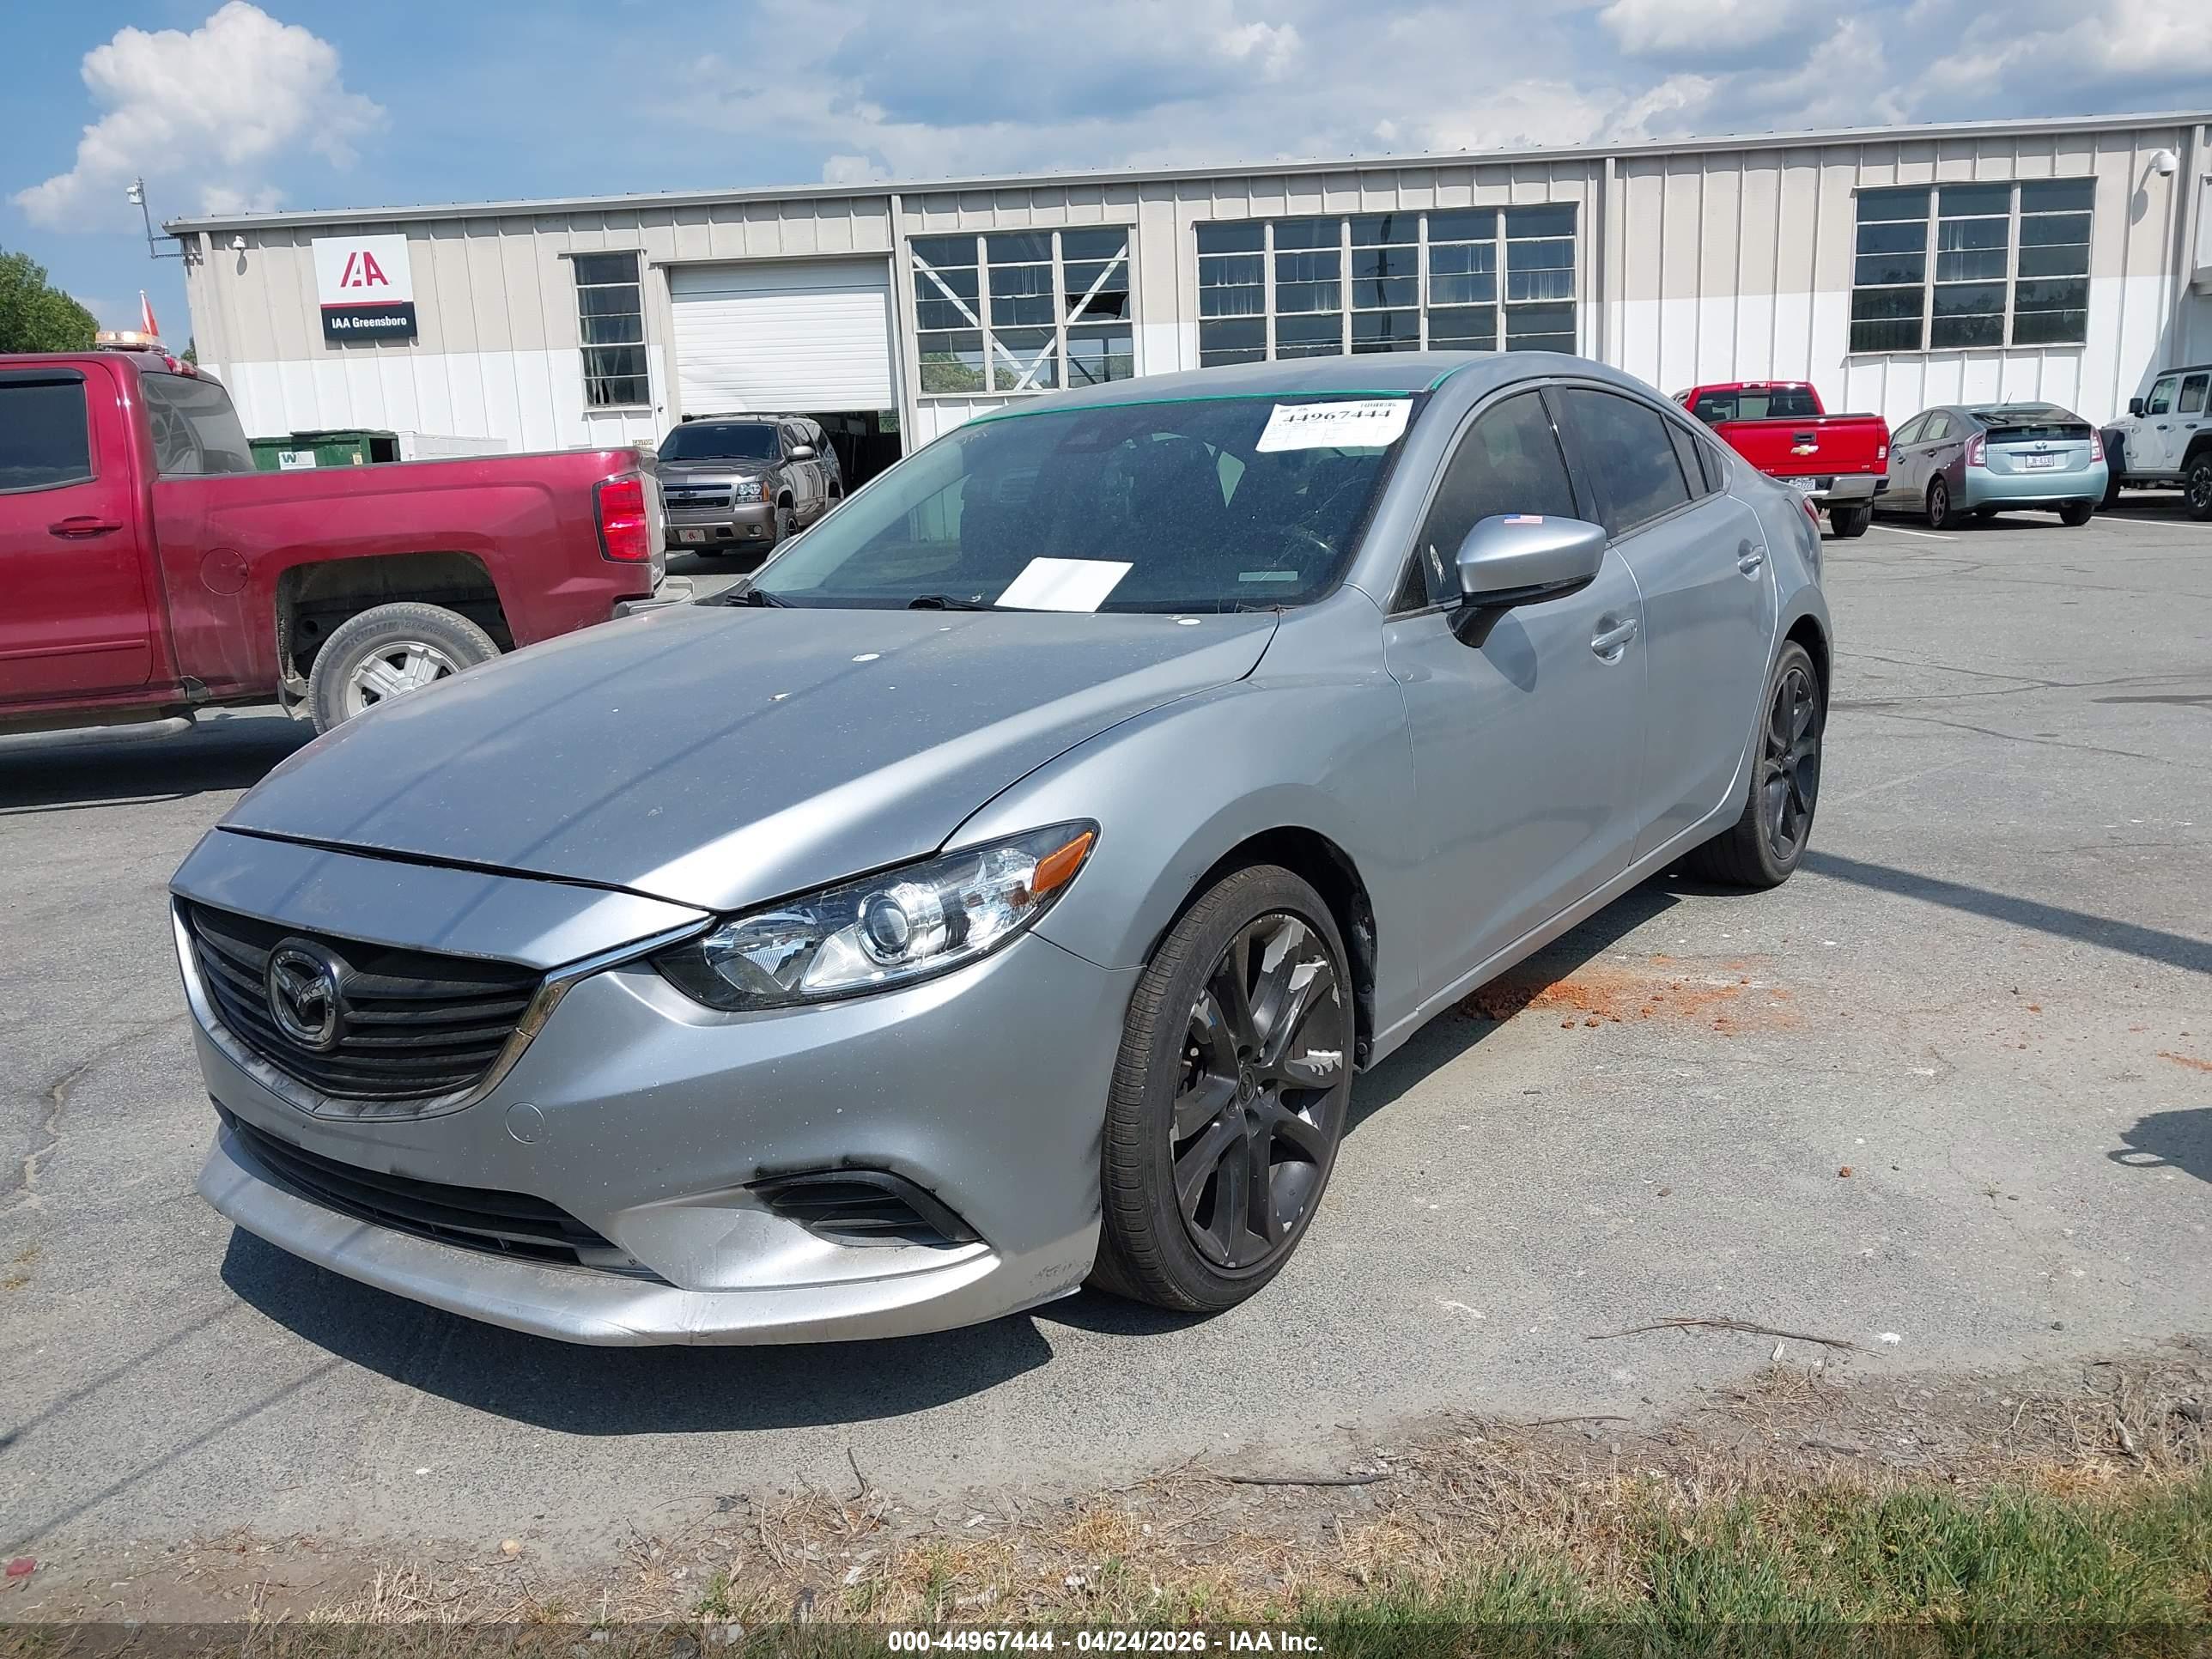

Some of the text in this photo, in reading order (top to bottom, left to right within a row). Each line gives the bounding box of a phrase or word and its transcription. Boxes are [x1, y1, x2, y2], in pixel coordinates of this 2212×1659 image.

[331, 315, 408, 329] IAA Greensboro
[1282, 409, 1392, 423] 44967444
